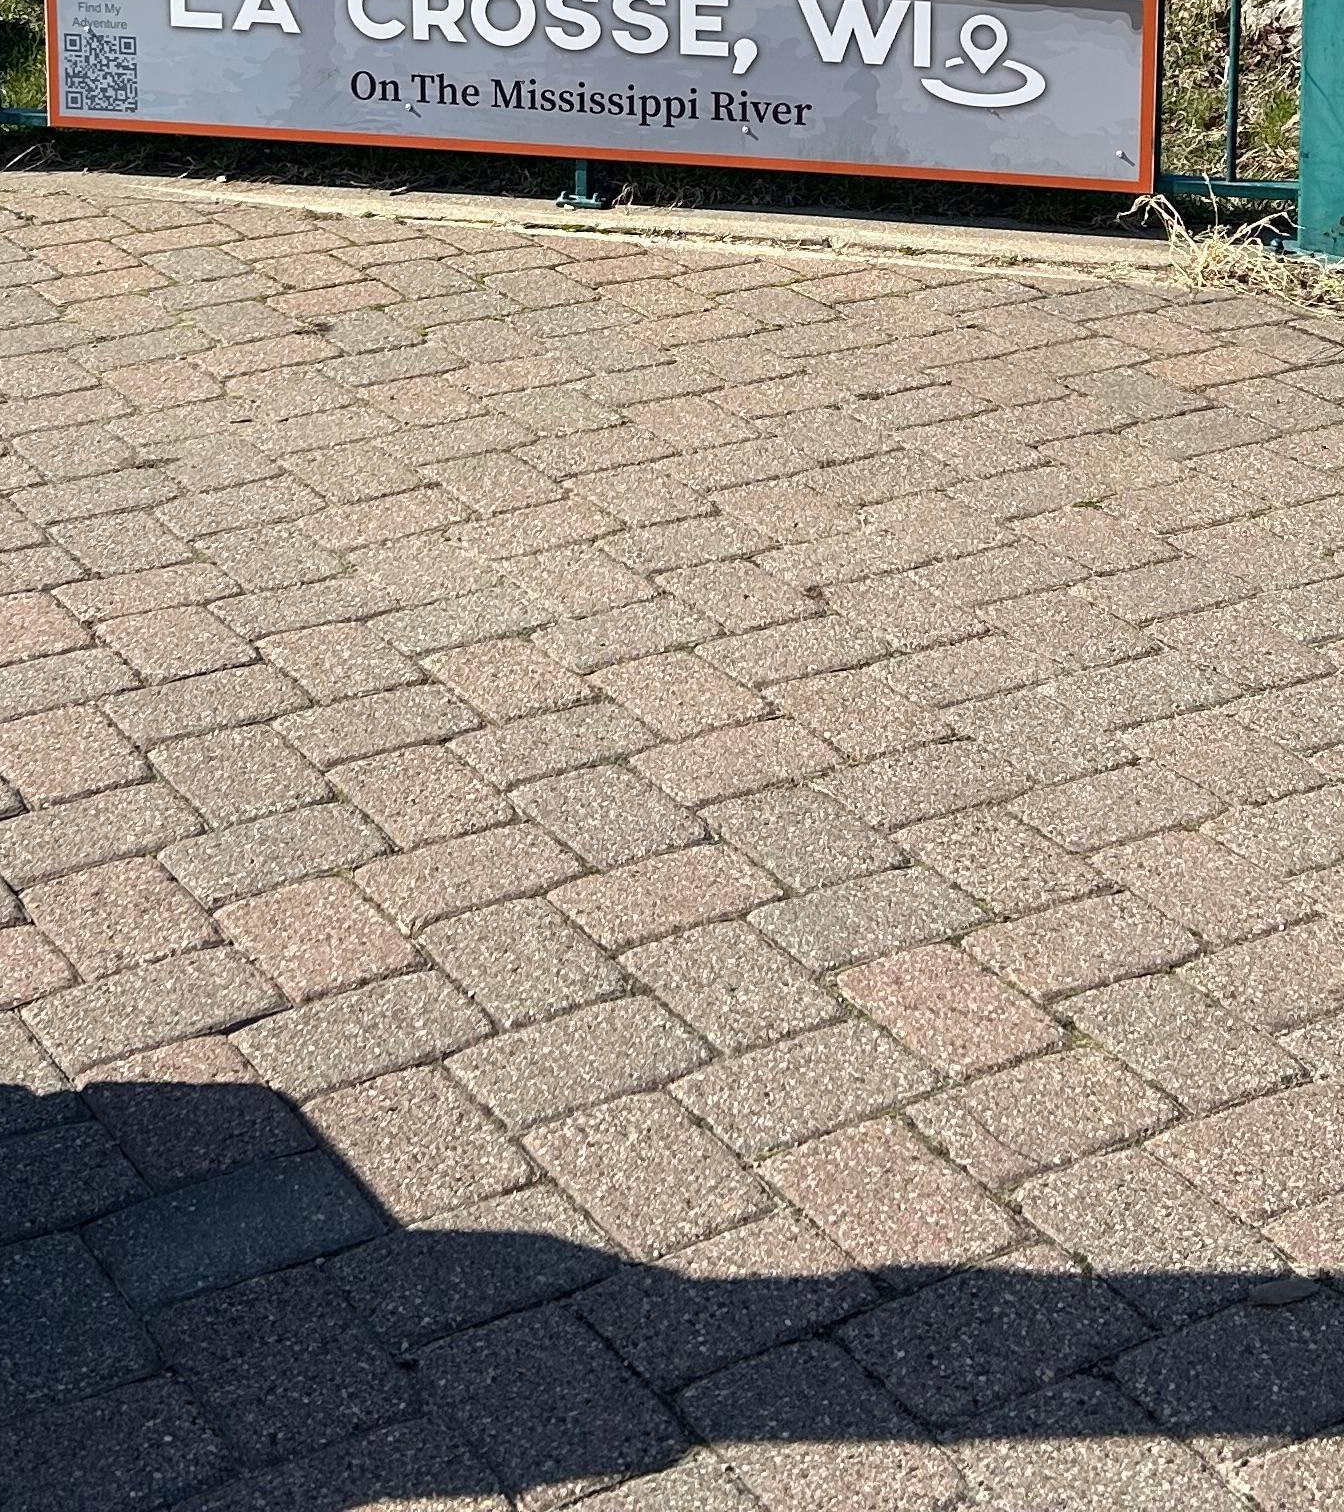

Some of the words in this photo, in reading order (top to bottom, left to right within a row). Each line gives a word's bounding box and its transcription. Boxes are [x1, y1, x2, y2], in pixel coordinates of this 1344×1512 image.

[78, 1, 101, 15] Find
[106, 3, 121, 15] My
[72, 16, 128, 31] Adventure
[351, 71, 401, 101] On
[410, 74, 481, 107] The
[491, 78, 700, 128] Mississippi
[711, 90, 812, 127] River
